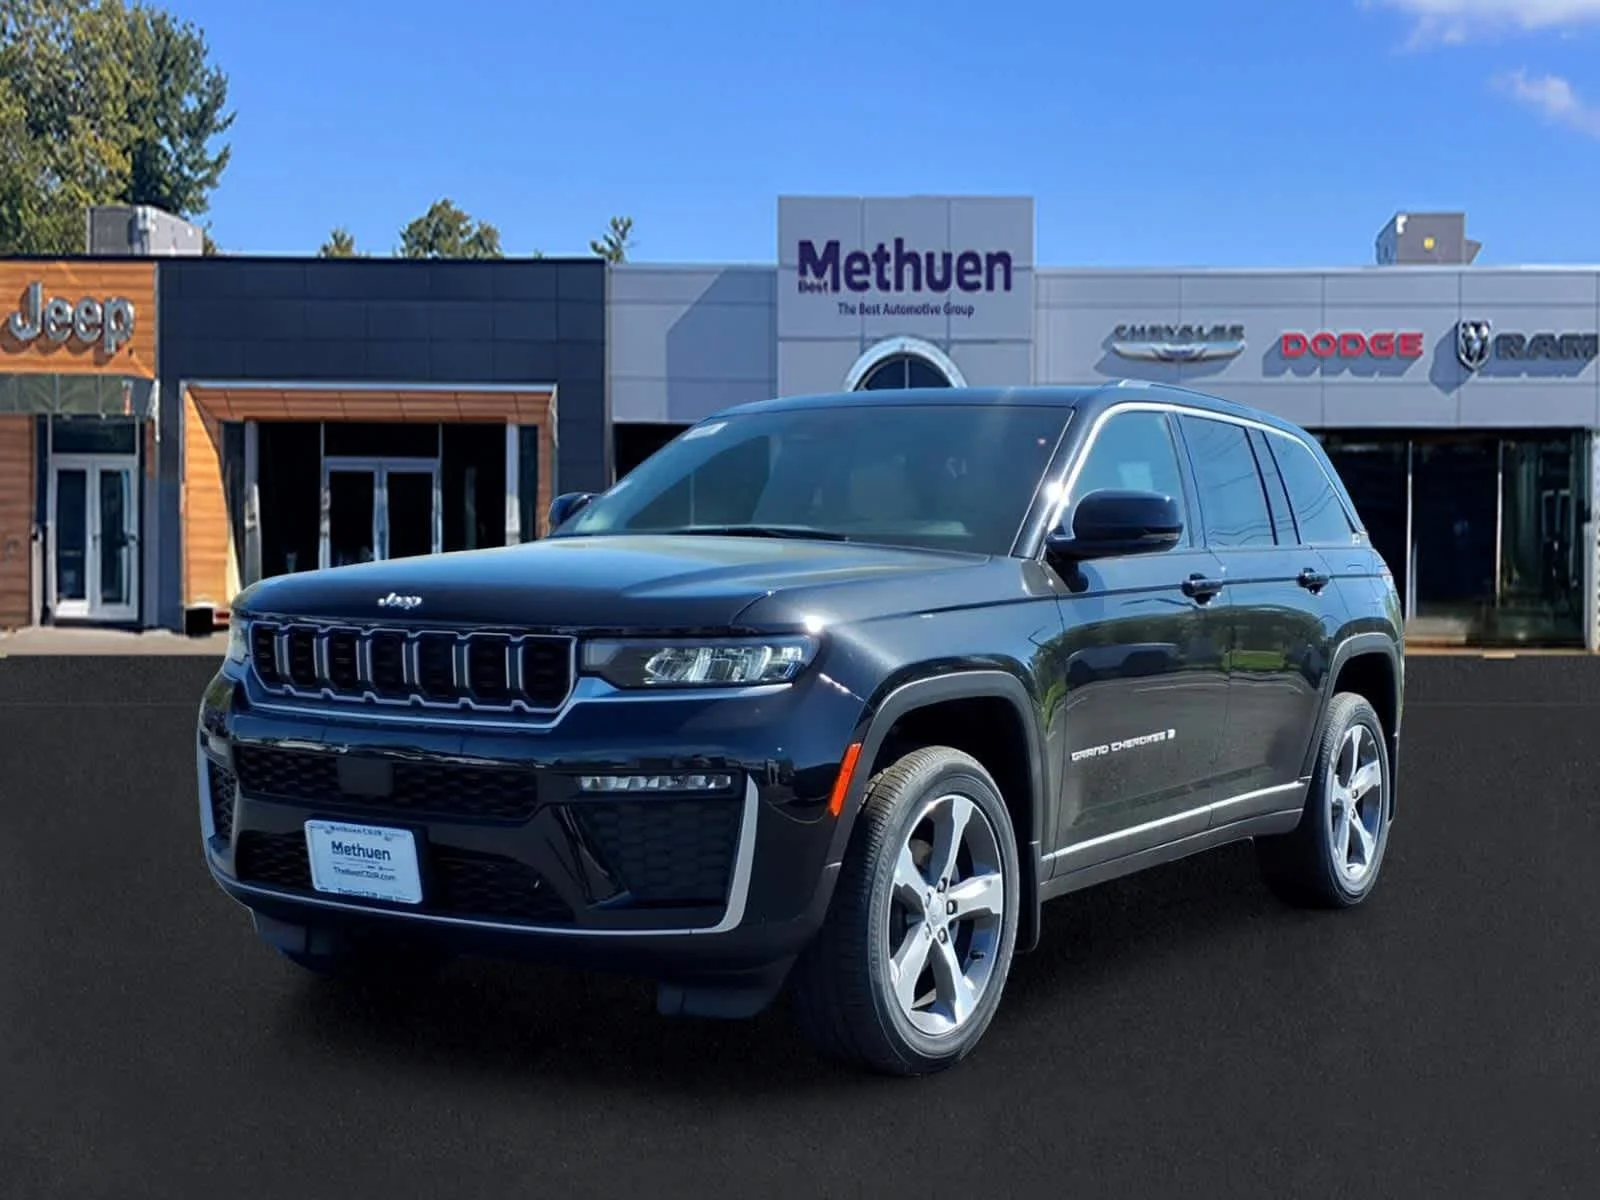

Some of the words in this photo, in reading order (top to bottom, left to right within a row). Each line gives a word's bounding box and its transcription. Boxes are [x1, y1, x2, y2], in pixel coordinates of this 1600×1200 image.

[798, 237, 1012, 292] Methuen
[8, 280, 135, 353] Jeep
[838, 302, 856, 315] The
[859, 302, 881, 315] Best
[883, 302, 940, 315] Automotive
[943, 302, 974, 318] Group
[1114, 324, 1245, 341] CHRYSLER
[1281, 332, 1424, 358] DODGE
[1495, 333, 1599, 360] RAM
[377, 592, 422, 610] Jeep
[1071, 744, 1109, 761] GRAND
[1111, 731, 1166, 752] CHEROKEE
[331, 840, 391, 860] Methuen
